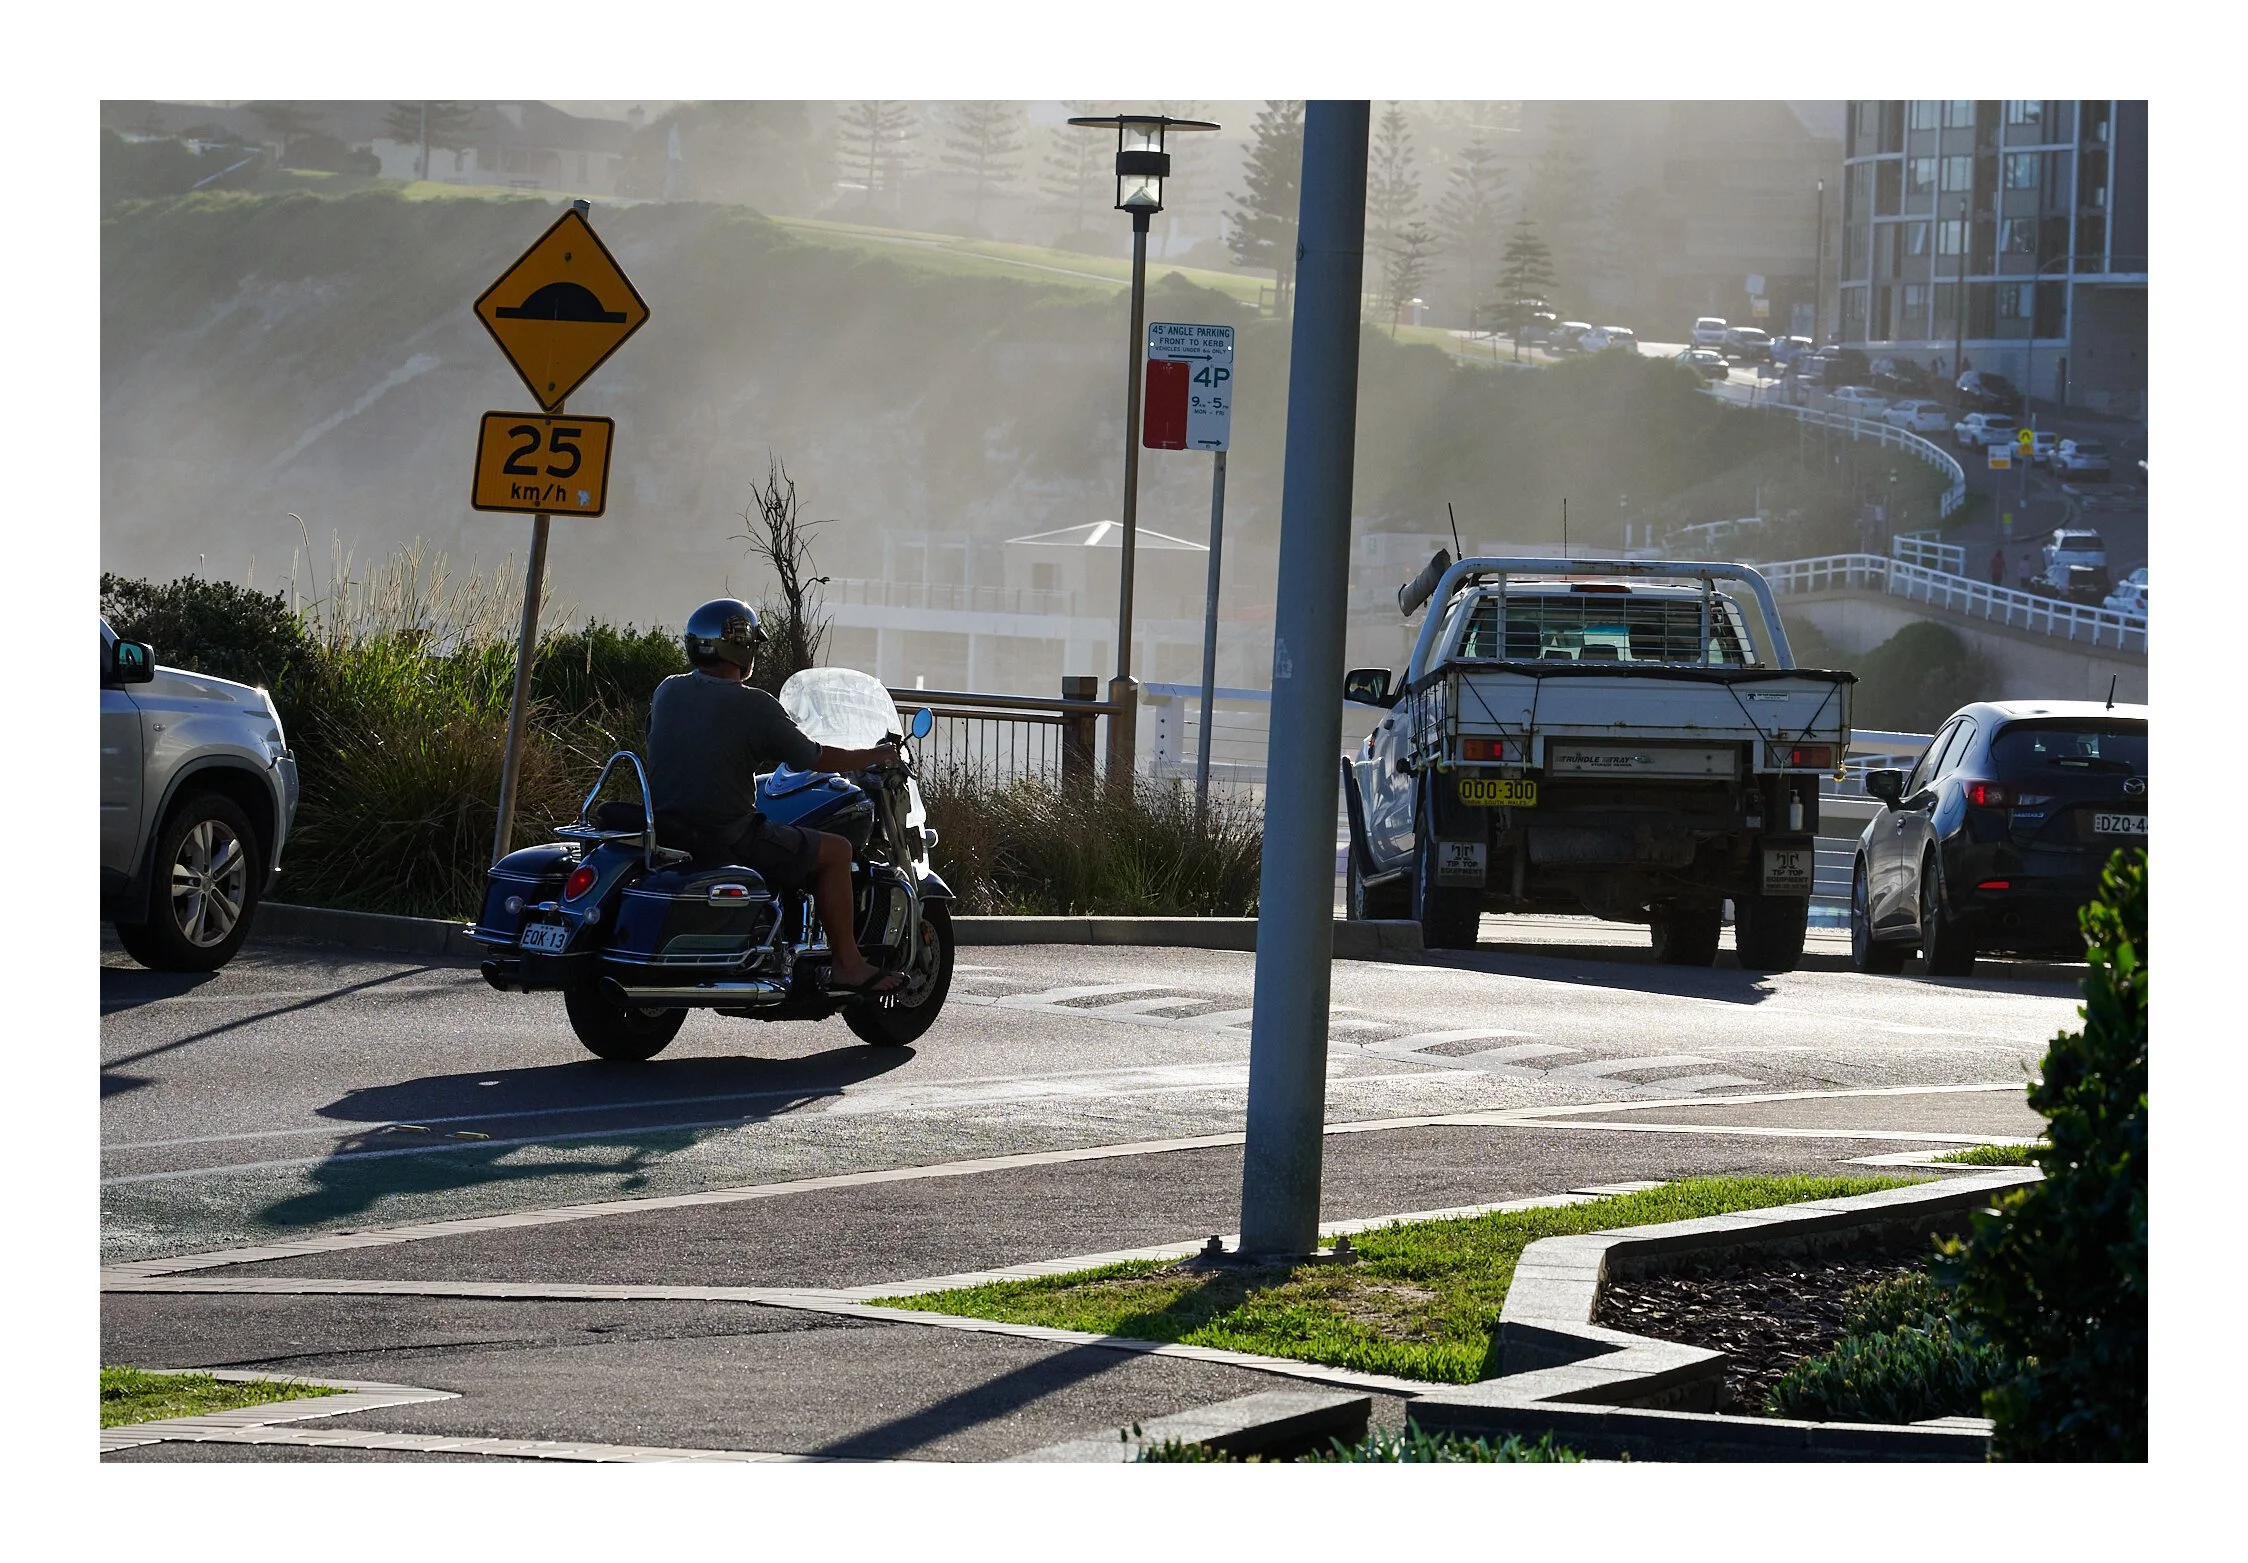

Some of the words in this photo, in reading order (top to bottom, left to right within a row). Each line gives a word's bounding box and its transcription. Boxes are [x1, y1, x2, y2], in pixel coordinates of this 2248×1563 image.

[1159, 338, 1185, 346] FRONT
[1167, 326, 1193, 336] ANGLE
[1197, 327, 1230, 338] PARKING
[1193, 366, 1231, 388] 4P
[502, 425, 582, 478] 25
[511, 482, 567, 502] km/h
